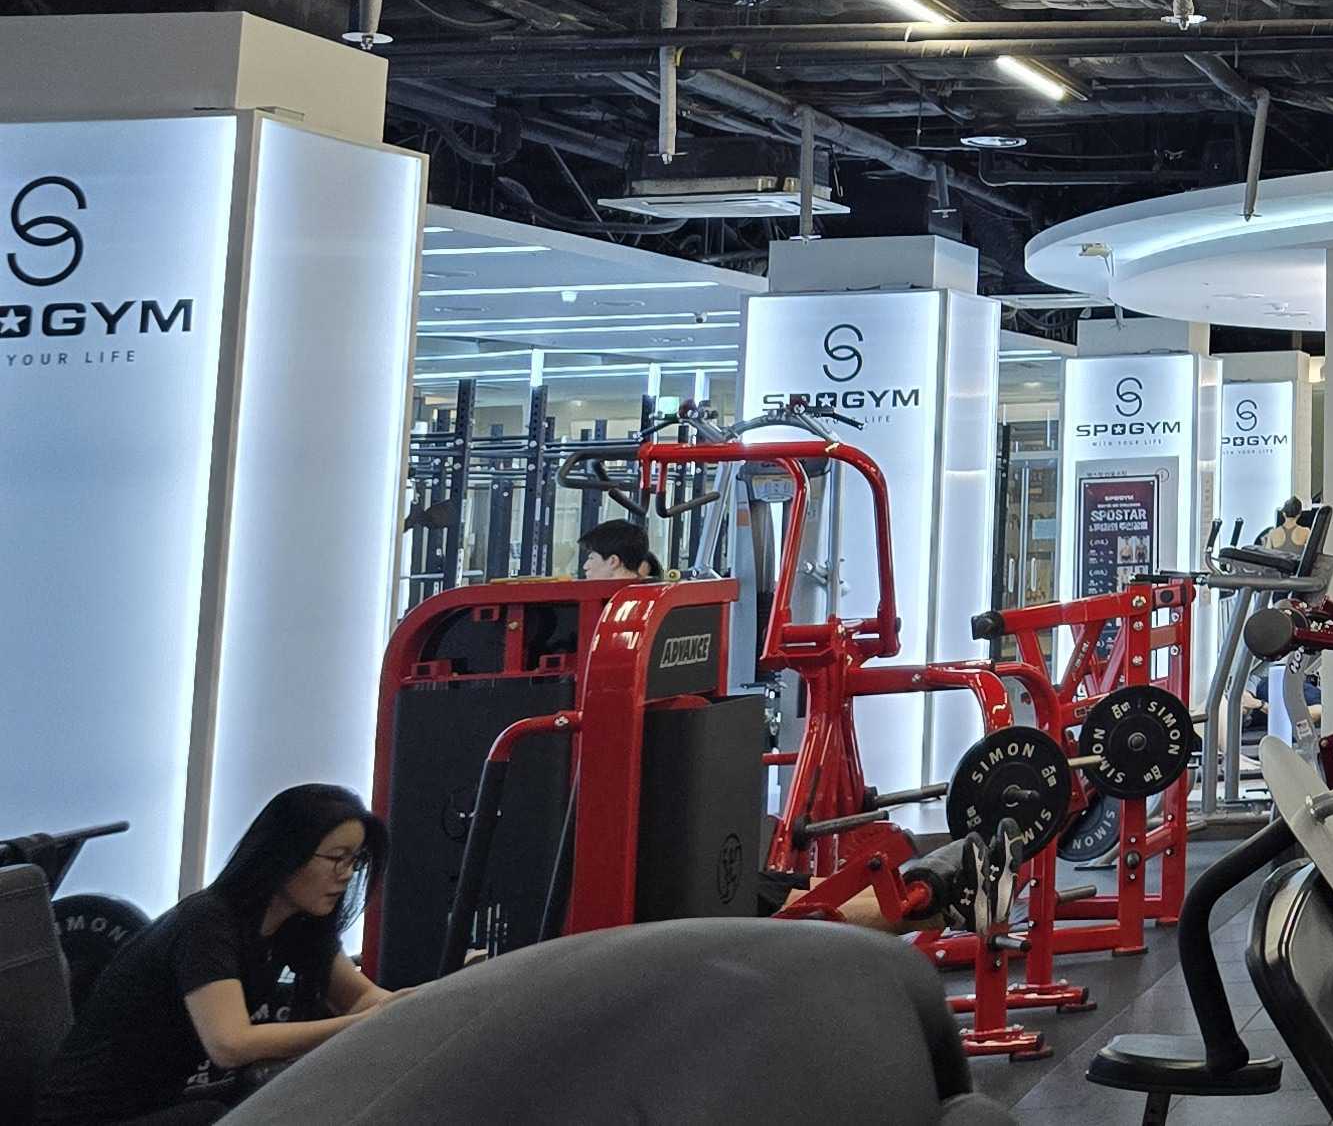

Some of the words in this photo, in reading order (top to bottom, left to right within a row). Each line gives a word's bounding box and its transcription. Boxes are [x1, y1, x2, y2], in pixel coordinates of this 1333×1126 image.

[7, 352, 68, 367] YOUR
[85, 350, 136, 365] LIFE
[1076, 421, 1181, 437] SPOGYM
[1090, 508, 1147, 522] SPOSTAR
[661, 634, 710, 667] ADVANCE
[1147, 700, 1181, 755] SIMON
[971, 742, 1035, 785] SIMON
[1072, 809, 1116, 850] SIMON
